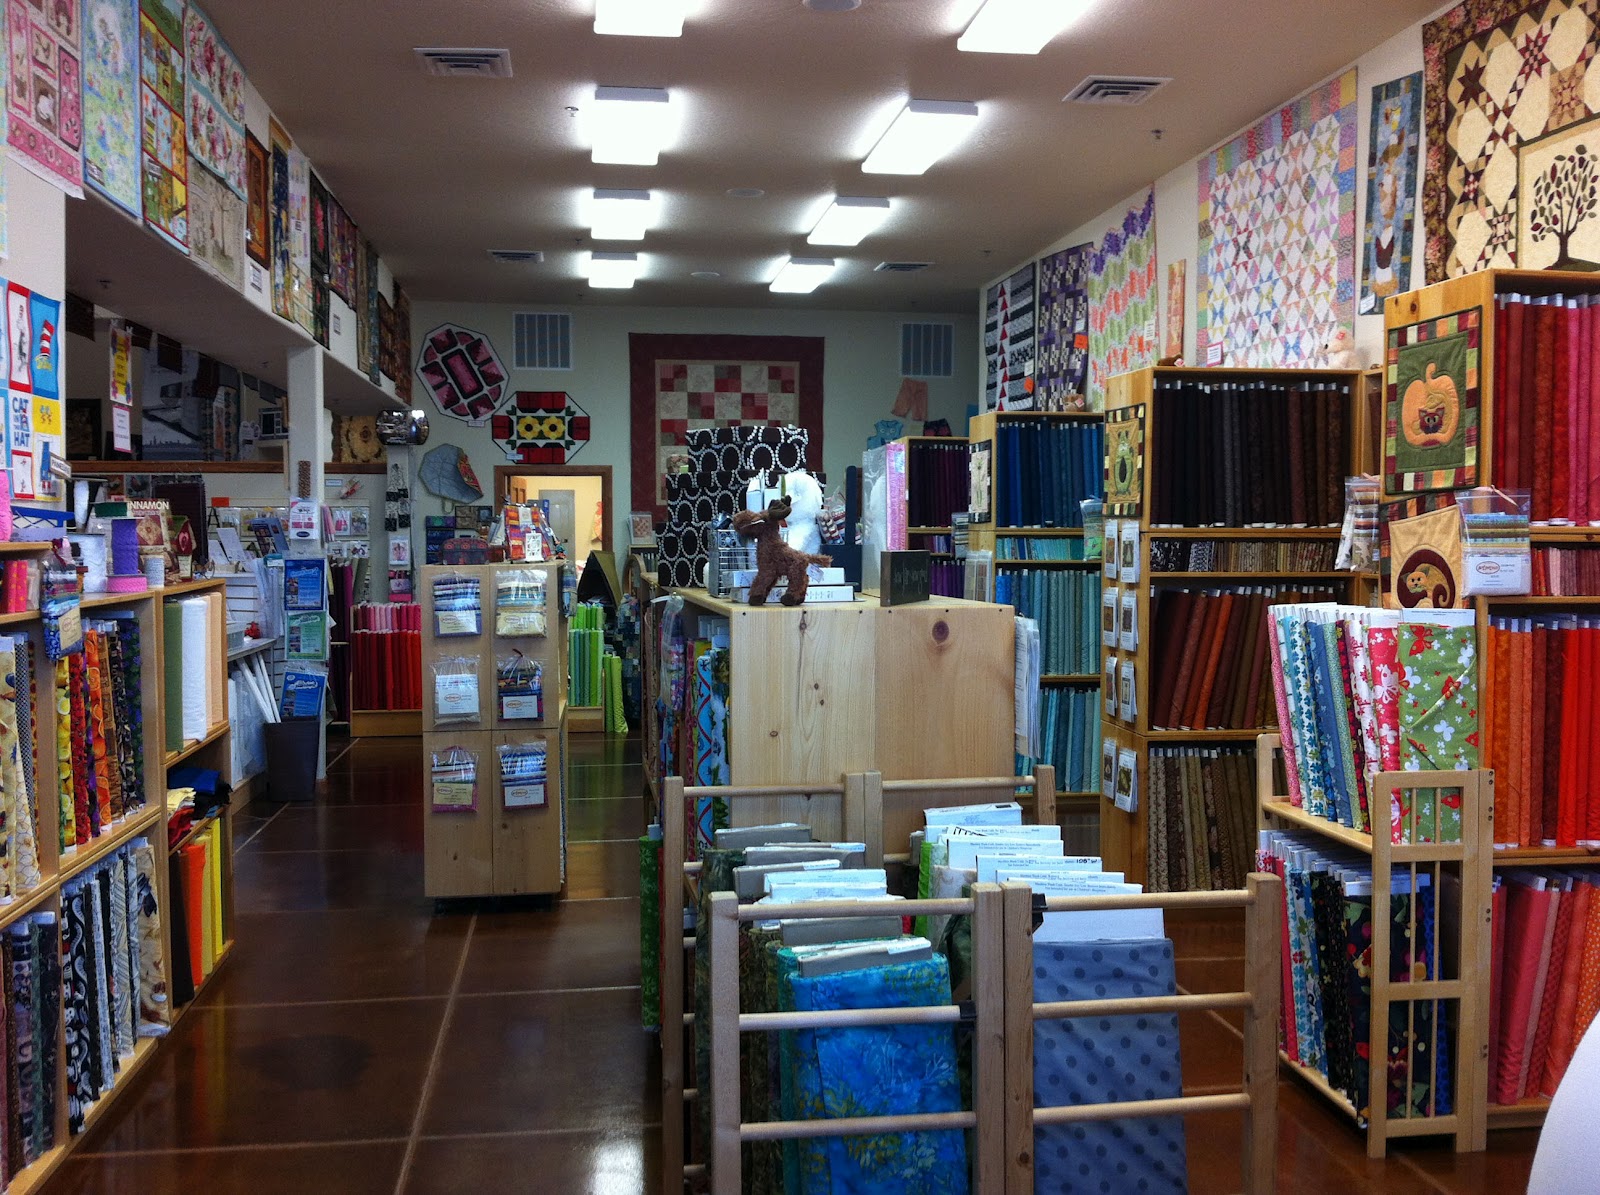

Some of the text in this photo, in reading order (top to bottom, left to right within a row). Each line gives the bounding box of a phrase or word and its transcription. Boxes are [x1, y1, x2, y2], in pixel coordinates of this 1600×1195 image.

[12, 397, 29, 413] CAT
[14, 431, 30, 448] HAT
[127, 500, 170, 510] INNAMON
